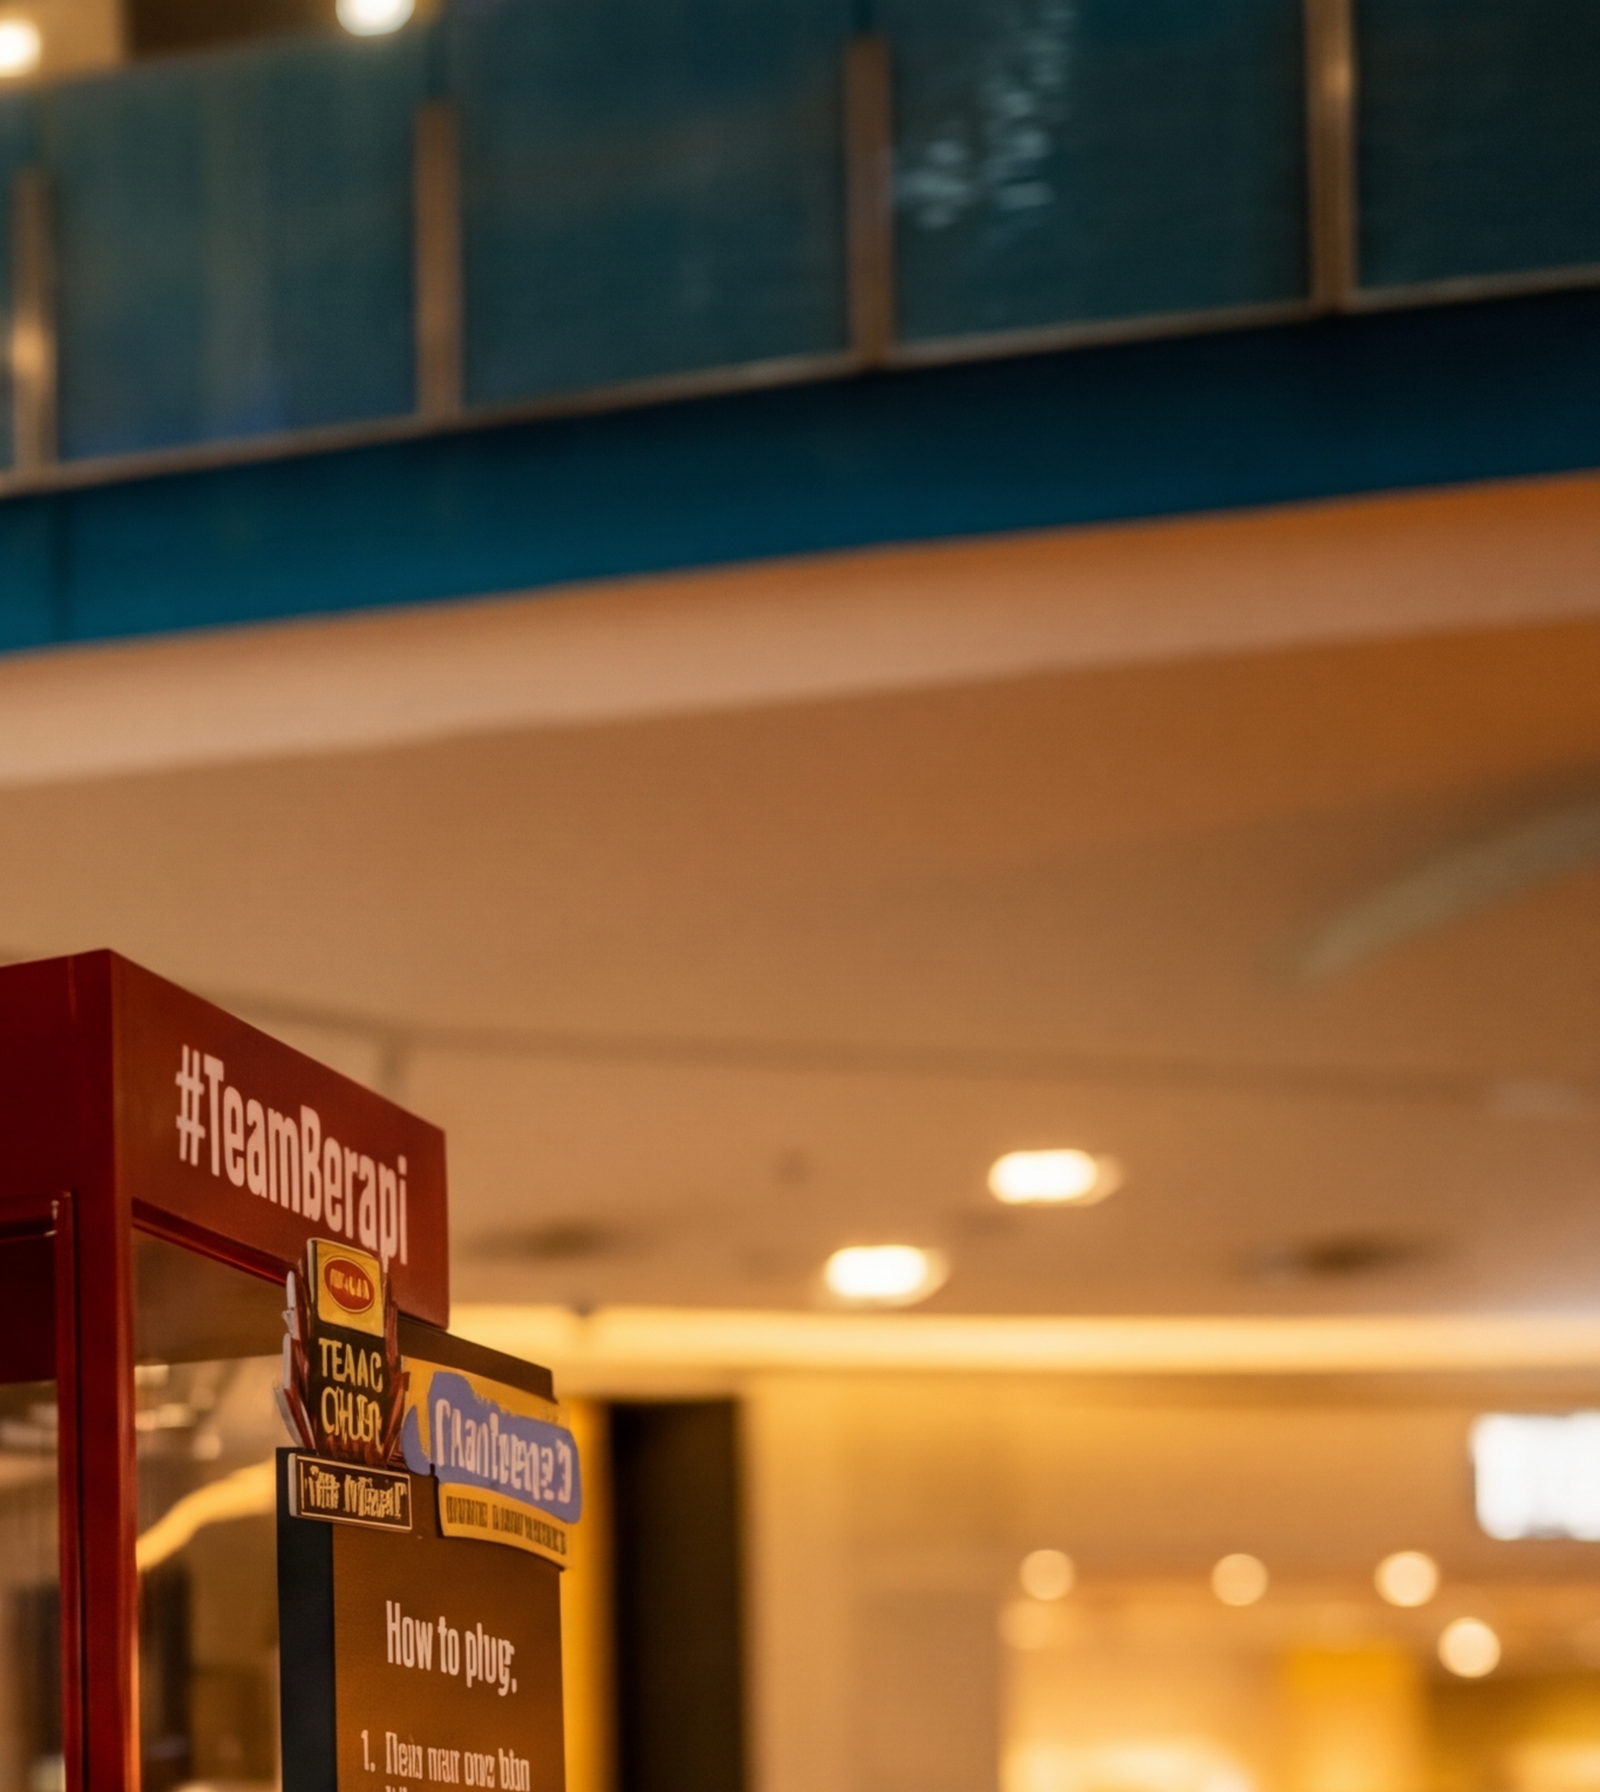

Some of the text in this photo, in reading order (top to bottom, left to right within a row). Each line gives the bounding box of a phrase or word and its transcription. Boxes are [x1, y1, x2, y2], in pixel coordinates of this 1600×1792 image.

[175, 1044, 408, 1272] #TeamBerapi
[386, 1600, 433, 1671] How
[437, 1616, 460, 1676] to
[360, 1729, 377, 1773] 1.
